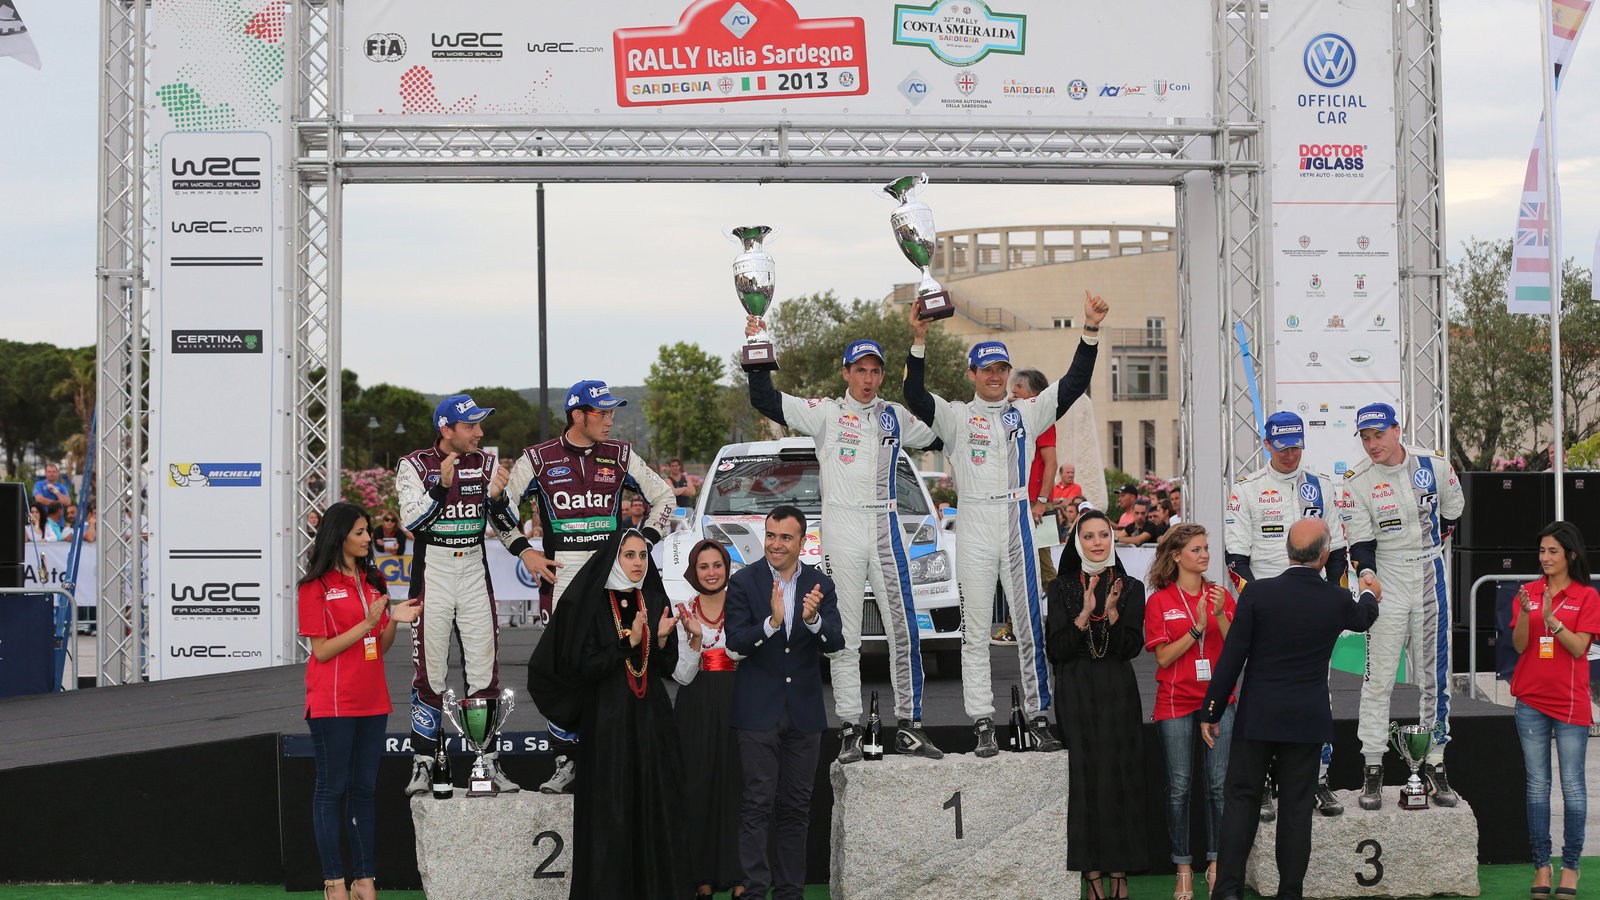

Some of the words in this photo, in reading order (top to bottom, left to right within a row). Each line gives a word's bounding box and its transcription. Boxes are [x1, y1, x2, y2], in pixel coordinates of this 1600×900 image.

[903, 20, 943, 34] COSTA
[945, 24, 1016, 40] SMERALDA
[431, 33, 503, 47] WRC
[939, 35, 980, 43] SARDEGNA
[628, 46, 701, 72] RALLY
[707, 46, 757, 68] Italia
[761, 43, 854, 67] Sardegna
[632, 81, 712, 95] SARDEGNA
[778, 72, 829, 91] 2013
[909, 83, 927, 93] ACI
[1003, 86, 1056, 94] SARDEGNA
[1169, 83, 1191, 91] Coni
[1297, 94, 1367, 108] OFFICIAL
[1317, 111, 1347, 125] CAR
[1298, 144, 1364, 158] DOCTOR
[171, 157, 261, 176] WRC
[176, 335, 243, 344] CERTINA
[209, 470, 261, 478] MICHELIN
[553, 489, 612, 511] Qatar
[457, 522, 482, 531] EDGE
[588, 520, 611, 529] EDGE
[433, 536, 479, 545] M-SPORT
[171, 583, 260, 602] WRC
[930, 586, 950, 595] EDGE
[958, 581, 968, 646] Volkswagen
[942, 791, 963, 839] 1
[532, 830, 566, 880] 2
[1354, 839, 1384, 887] 3
